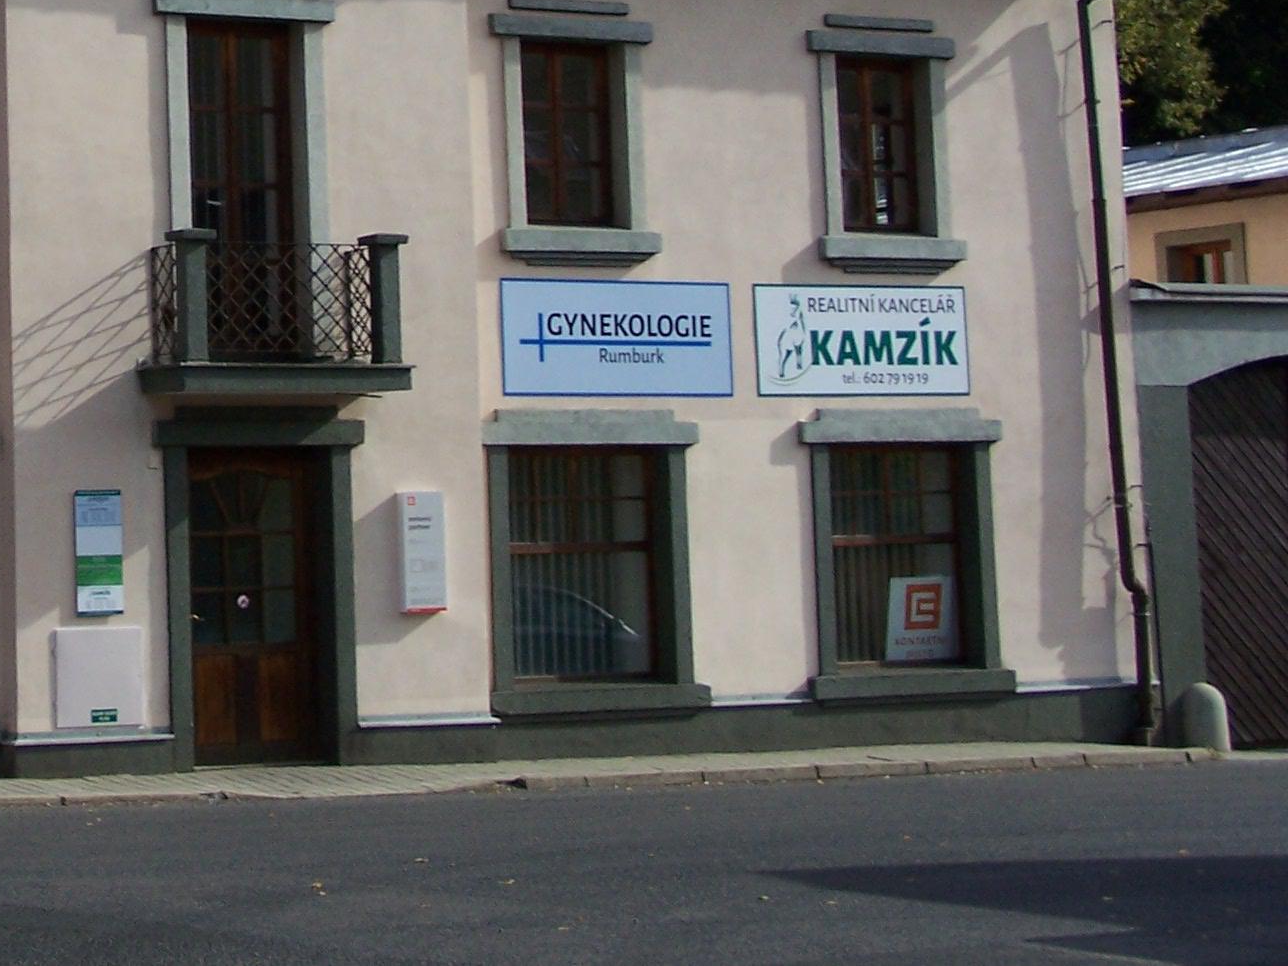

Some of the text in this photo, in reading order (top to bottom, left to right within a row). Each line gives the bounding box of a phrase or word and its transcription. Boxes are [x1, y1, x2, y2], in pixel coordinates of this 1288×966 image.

[807, 294, 956, 314] REALITNÍ KANCELÁŘ
[547, 312, 713, 338] GYNEKOLOGIE
[809, 317, 959, 366] KAMZÍK
[599, 347, 665, 364] Rumburk
